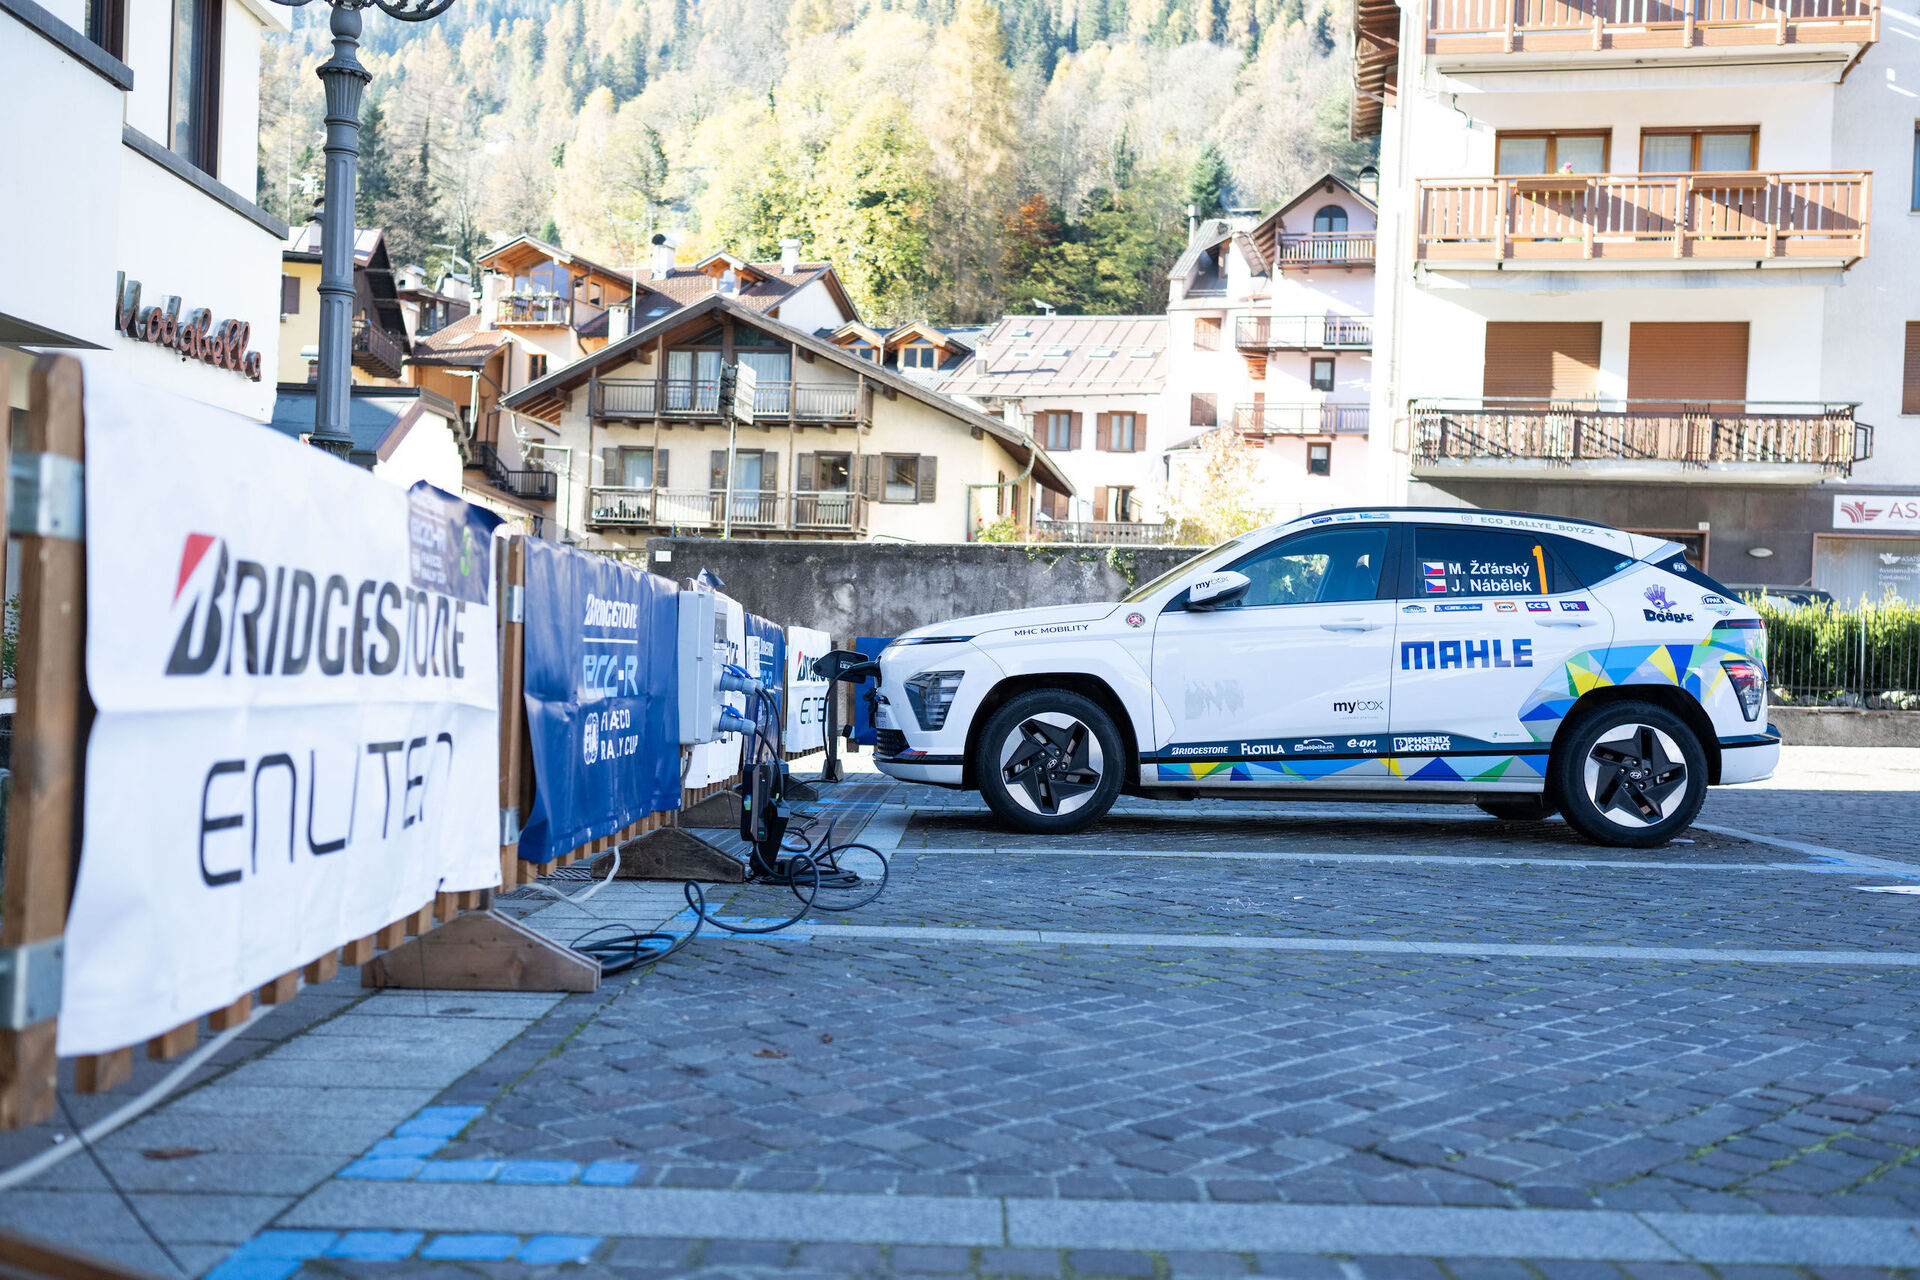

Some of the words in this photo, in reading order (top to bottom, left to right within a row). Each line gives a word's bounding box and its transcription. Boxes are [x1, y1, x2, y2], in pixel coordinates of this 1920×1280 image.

[1888, 502, 1920, 519] AS
[1480, 516, 1596, 535] ECO_RALLYE_BOYZZ
[1448, 563, 1466, 575] M.
[1470, 560, 1530, 577] Žďárský
[1532, 545, 1549, 594] 1
[1452, 580, 1465, 592] J.
[1470, 578, 1533, 592] Nábělek
[164, 532, 466, 680] BRIDGESTONE
[1014, 628, 1038, 637] MHC
[1040, 624, 1089, 634] MOBILITY
[1401, 639, 1533, 670] MAHLE
[1333, 699, 1384, 713] mybox
[1171, 747, 1229, 755] BRIDGESTONE
[1241, 743, 1285, 755] FLOTILA
[1408, 743, 1450, 751] CONTACT
